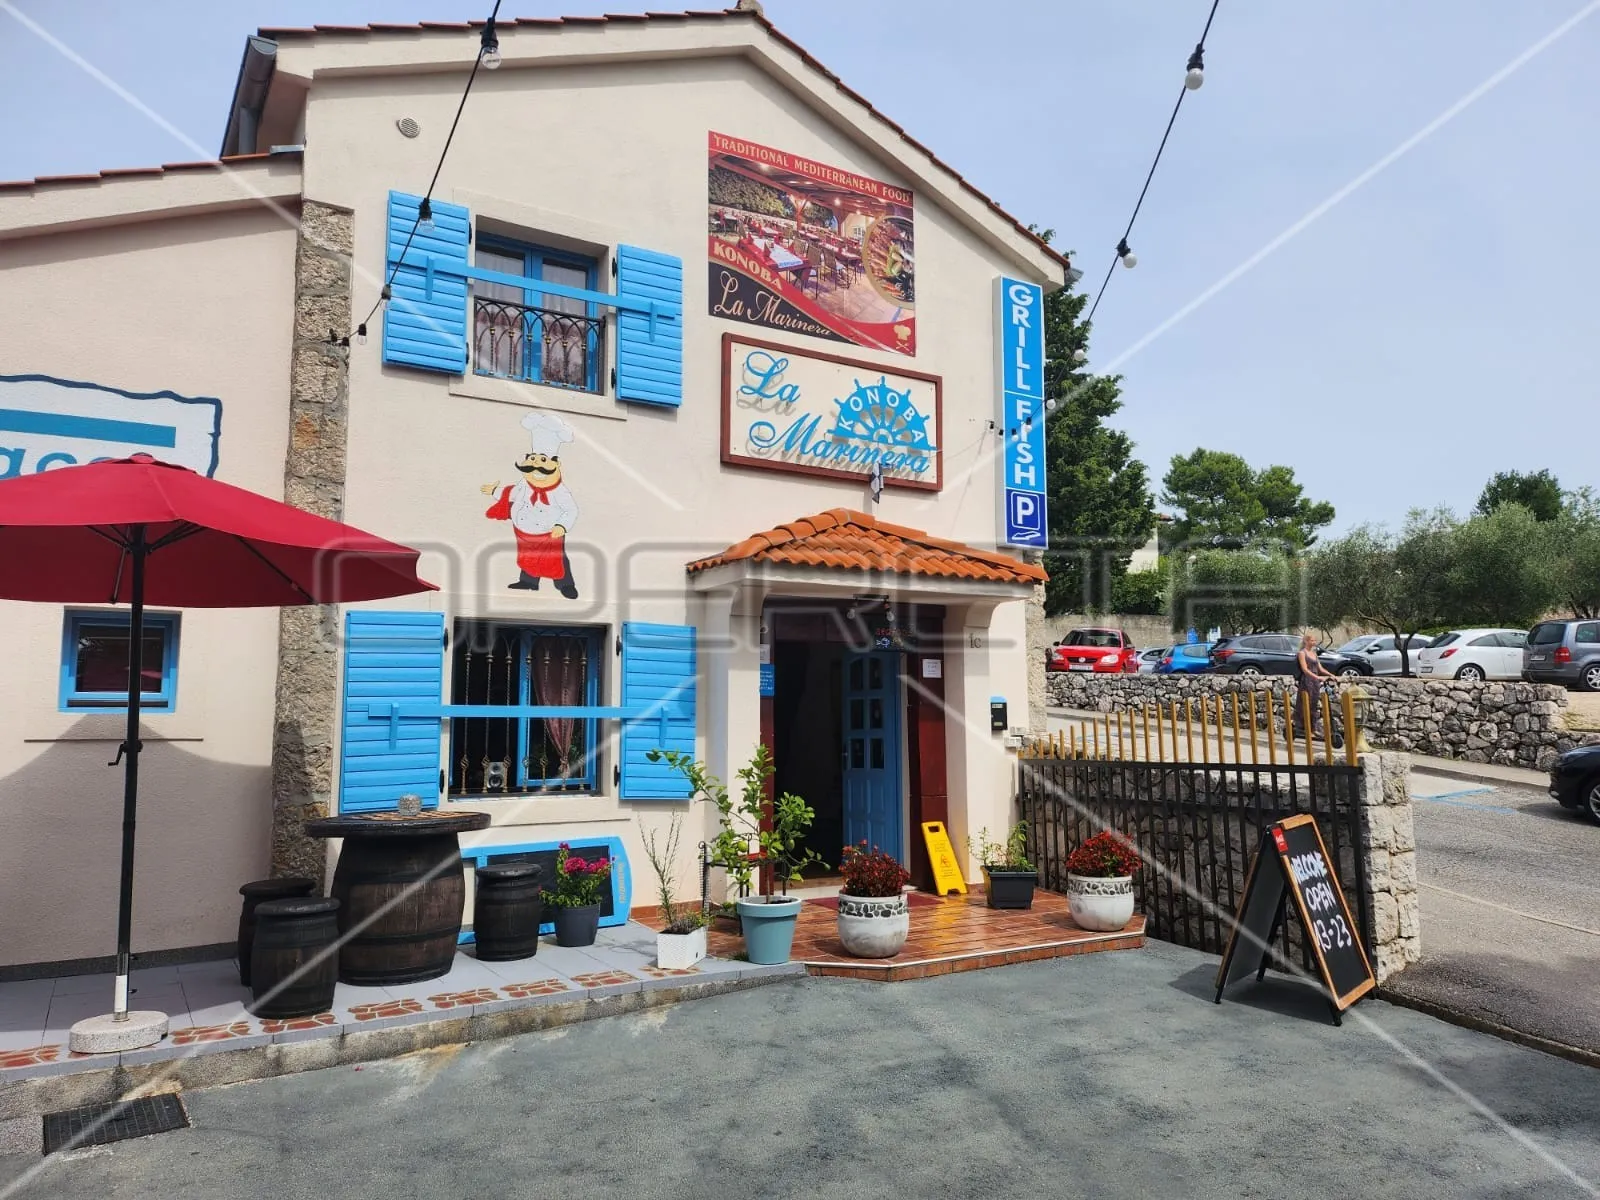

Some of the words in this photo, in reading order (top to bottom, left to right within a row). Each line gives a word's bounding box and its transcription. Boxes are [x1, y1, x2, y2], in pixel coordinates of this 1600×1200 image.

[714, 134, 790, 168] TRADITIONAL
[794, 160, 878, 194] MEDITERRANEAN
[882, 186, 911, 203] FOOD
[713, 241, 784, 291] KONOBA
[713, 270, 745, 317] La
[746, 290, 833, 336] Marinera
[1008, 284, 1034, 391] GRILL
[740, 351, 800, 403] La
[748, 412, 930, 473] Marinera
[838, 388, 925, 443] KONOBA
[1014, 399, 1036, 487] FISH
[1305, 880, 1337, 913] OPEN
